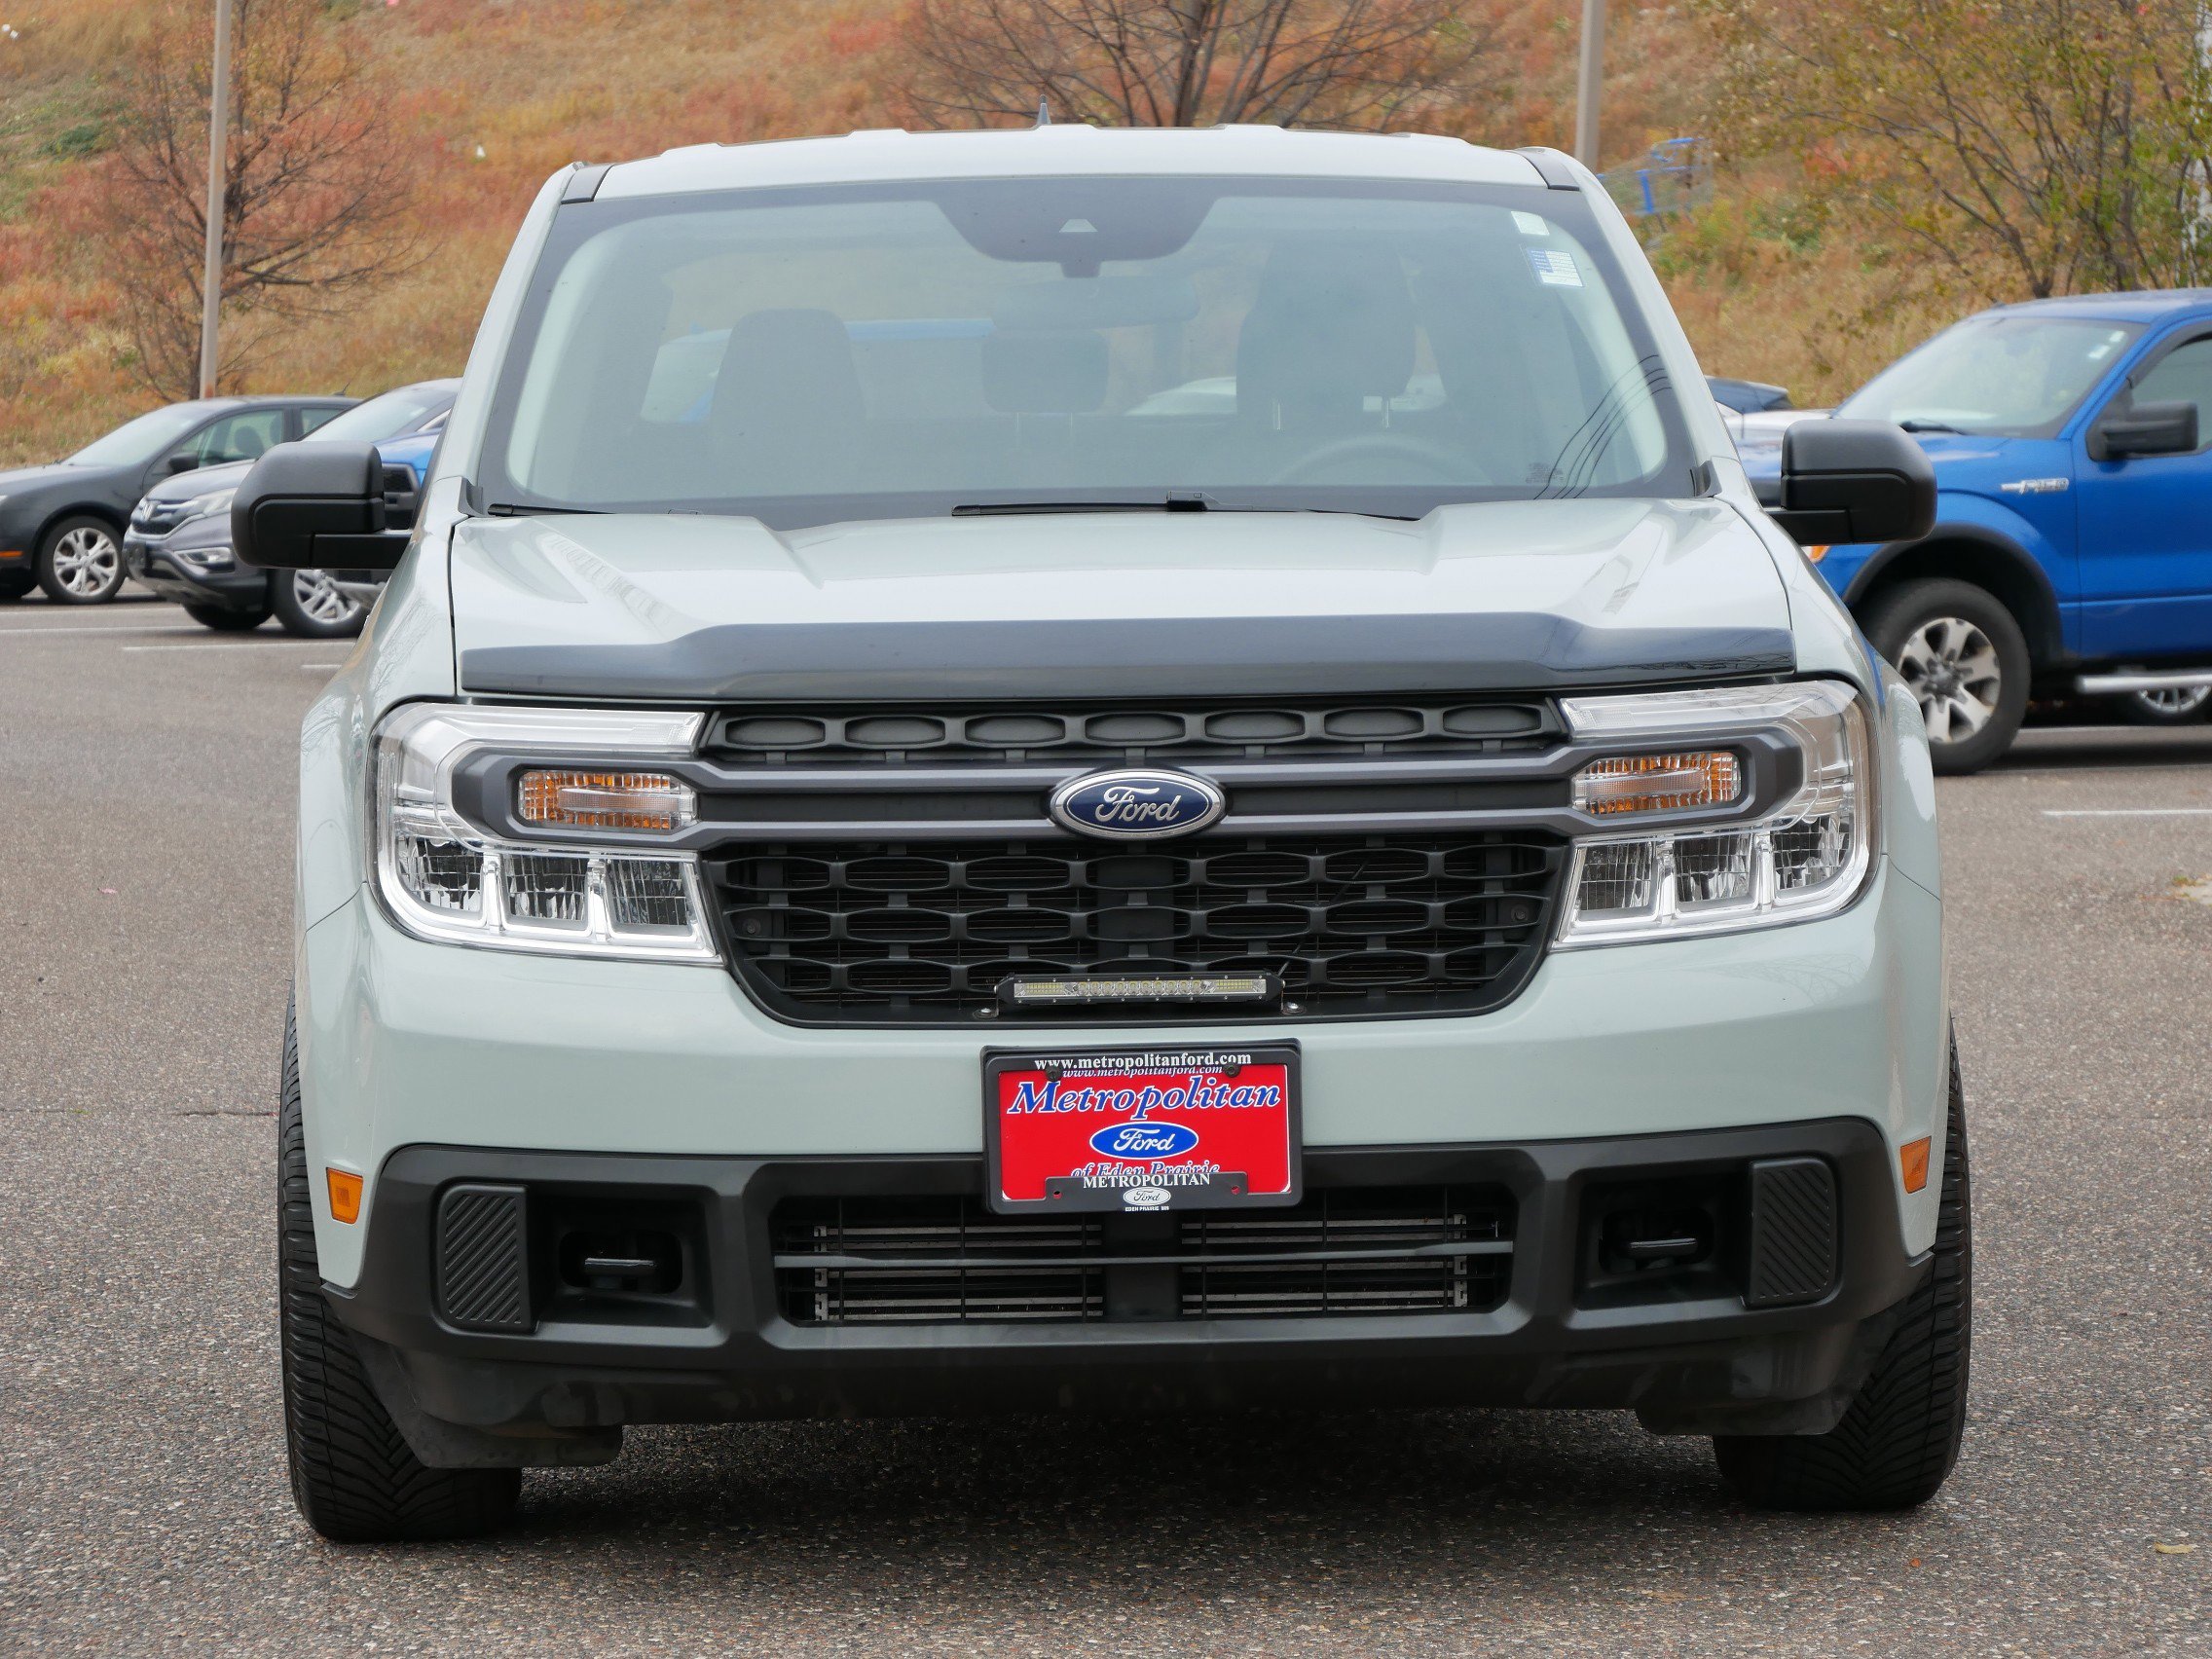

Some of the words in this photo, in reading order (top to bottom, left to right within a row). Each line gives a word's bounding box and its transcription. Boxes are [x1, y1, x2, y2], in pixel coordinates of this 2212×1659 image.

[1095, 786, 1182, 822] Ford
[1035, 1051, 1251, 1071] www.metropolitanford.com
[1007, 1076, 1280, 1120] Metropolitan
[1113, 1127, 1175, 1151] Ford
[1071, 1161, 1095, 1176] of
[1096, 1161, 1145, 1175] Eden
[1151, 1160, 1221, 1175] Prairie
[1083, 1173, 1211, 1189] METROPOLITAN
[1133, 1190, 1161, 1201] Ford
